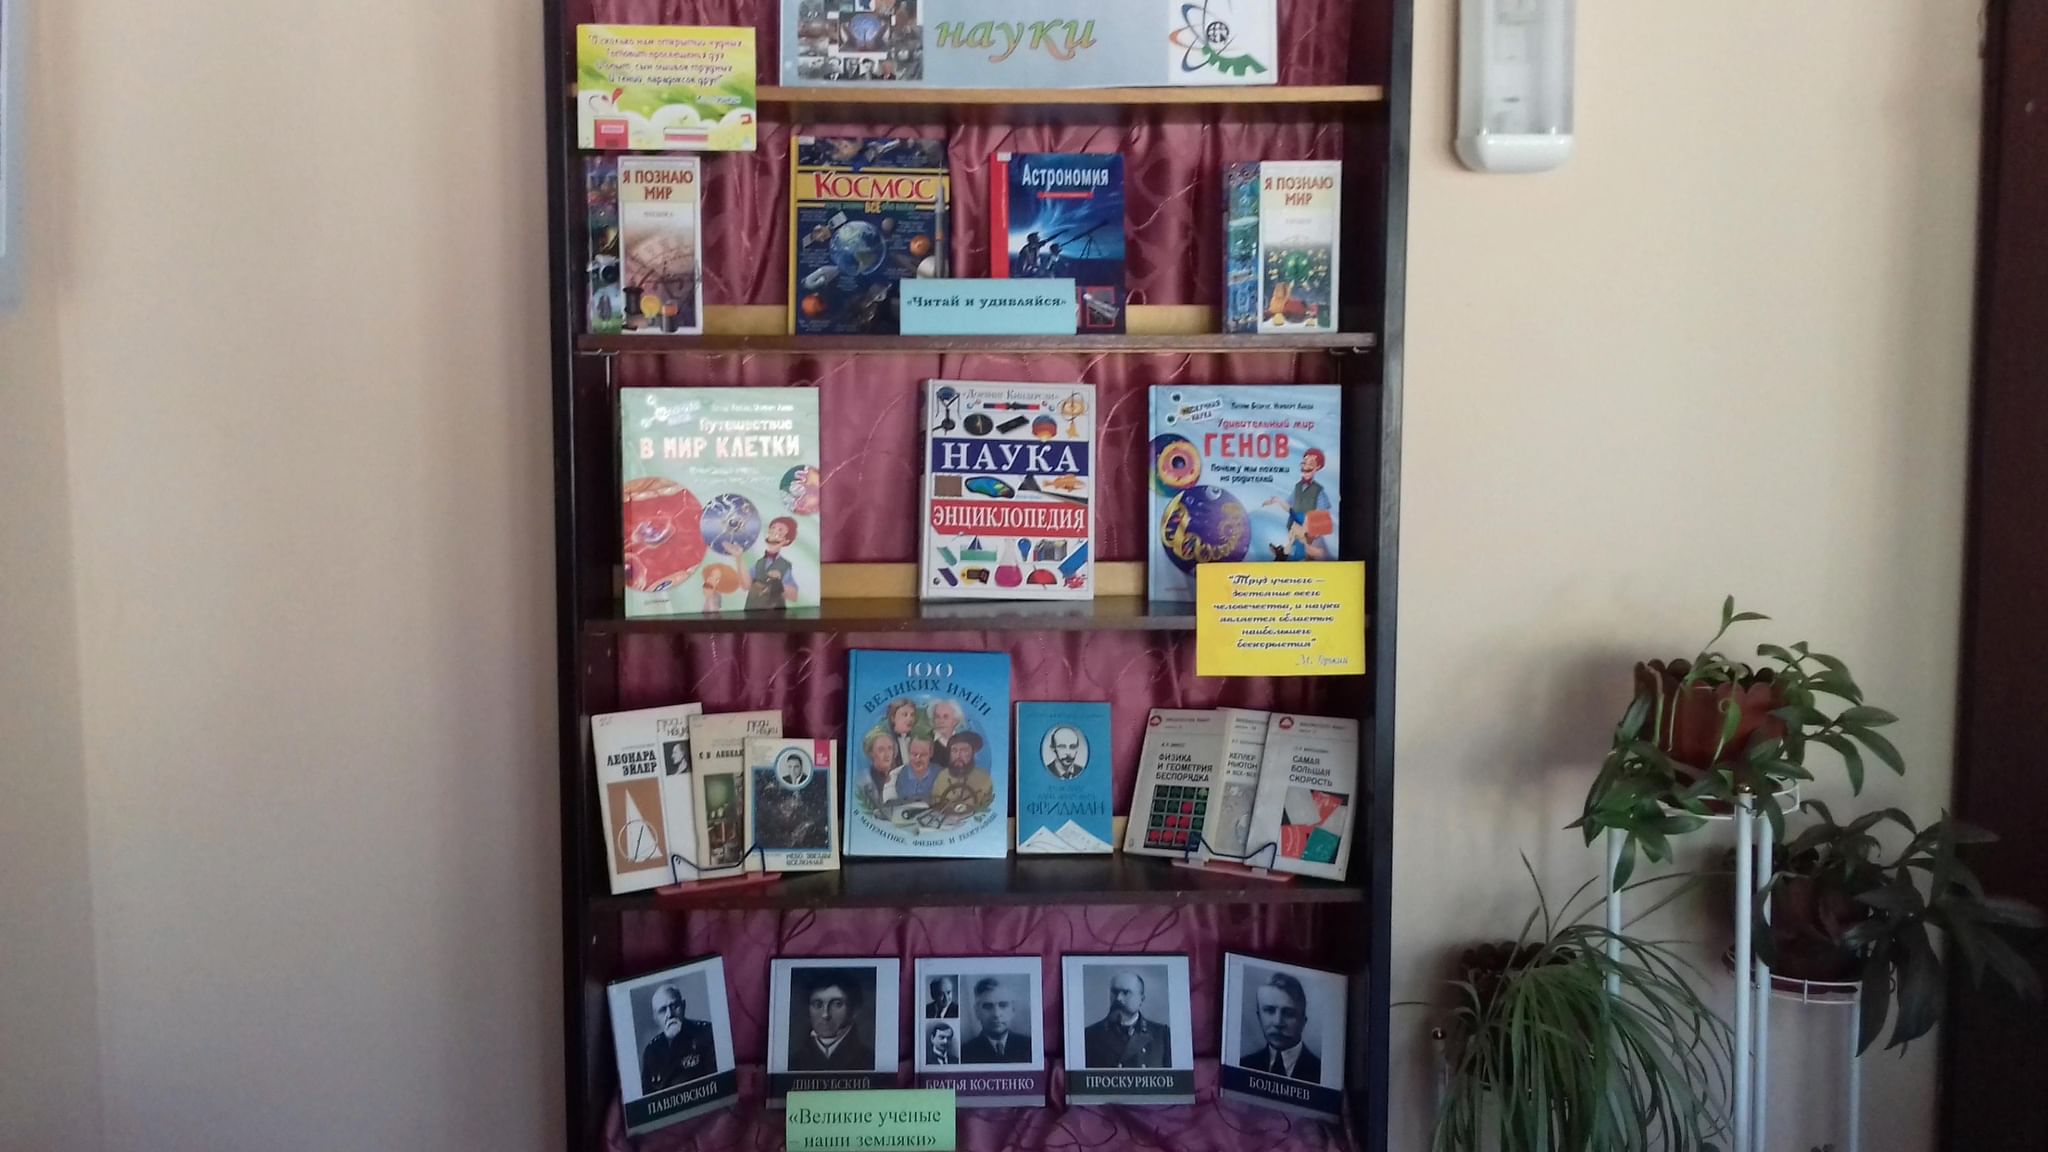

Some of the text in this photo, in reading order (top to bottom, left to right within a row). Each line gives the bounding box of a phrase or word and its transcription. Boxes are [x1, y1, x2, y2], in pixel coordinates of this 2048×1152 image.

[935, 19, 1097, 63] науки
[623, 170, 694, 184] Я ПОЗНАЮ
[1022, 163, 1109, 188] Астрономия
[1265, 176, 1334, 190] Я ПОЗНАЮ
[644, 186, 673, 200] МИР
[1285, 192, 1313, 206] МИР
[966, 299, 974, 307] и
[700, 417, 793, 434] Путешествие
[1293, 420, 1314, 431] мир
[640, 435, 800, 459] В МИР КЛЕТКИ
[1204, 432, 1290, 459] ГЕНОВ
[941, 442, 1080, 473] НАУКА
[1211, 463, 1241, 473] Почему
[933, 505, 1085, 530] ЭНЦИКЛОПЕДИЯ
[1271, 577, 1312, 586] ученого
[1232, 590, 1291, 598] достояние
[1305, 603, 1340, 611] наука
[1220, 613, 1334, 623] является областью
[1242, 626, 1312, 636] наибольшего
[907, 662, 954, 677] 100
[864, 679, 940, 714] ВЕЛИКИХ
[607, 750, 657, 767] ЛЕОНАРД
[1159, 753, 1192, 762] ФИЗИКА
[1229, 752, 1256, 761] КЕПЛЕР
[1292, 755, 1320, 765] САМАЯ
[622, 761, 658, 777] ЭЙЛЕР
[1157, 762, 1213, 772] И ГЕОМЕТРИЯ
[1227, 761, 1258, 770] НЬЮТОН
[1291, 765, 1331, 776] БОЛЬШАЯ
[1156, 772, 1209, 782] БЕСПОРЯДКА
[1289, 774, 1333, 787] СКОРОСТЬ
[1027, 801, 1105, 816] ФРИДМАН
[926, 1078, 1035, 1091] БРАТЬЯ КОСТЕНКО
[1086, 1075, 1175, 1089] ПРОСКУРЯКОВ
[1249, 1076, 1311, 1101] БОЛДЫРЕВ
[648, 1081, 719, 1115] ПАВЛОВСКИЙ
[789, 1108, 873, 1124] «Великие
[804, 1136, 850, 1147] наши
[855, 1135, 937, 1147] земляки»
